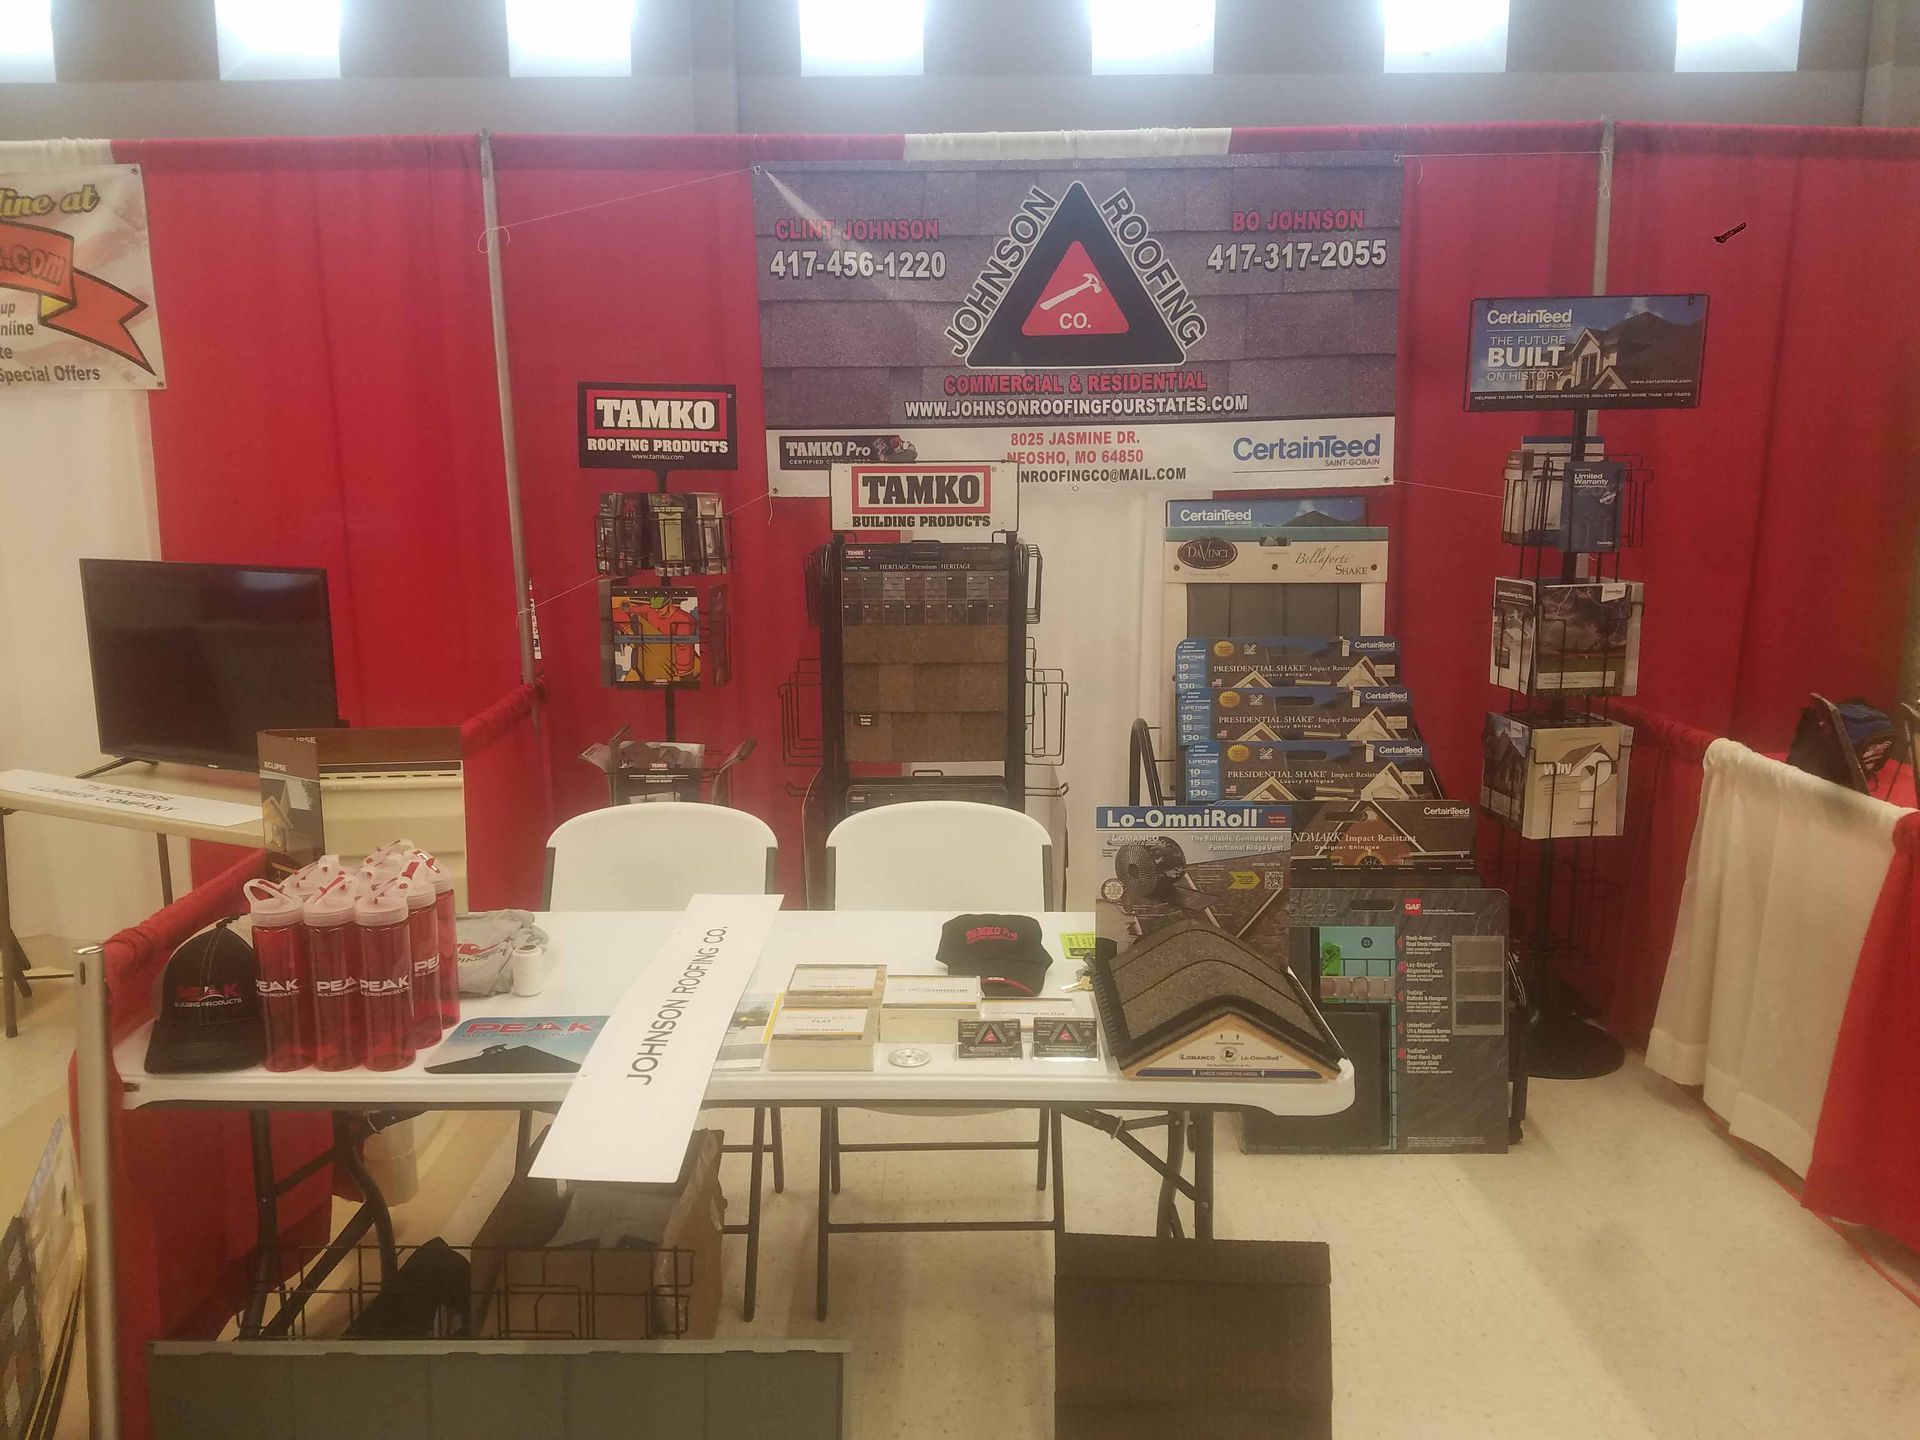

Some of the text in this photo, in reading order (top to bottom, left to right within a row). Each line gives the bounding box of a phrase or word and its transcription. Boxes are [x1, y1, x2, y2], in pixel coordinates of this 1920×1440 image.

[60, 183, 100, 213] at
[1232, 208, 1365, 232] BO JOHNSON
[775, 218, 940, 241] CLINT JOHNSON
[1207, 239, 1387, 272] 417-317-2055
[770, 250, 946, 279] 417-456-1220
[944, 185, 1058, 358] JOHNSON
[1100, 187, 1208, 350] ROOFING
[1059, 312, 1091, 329] CO.
[1487, 308, 1573, 325] CertainTeed
[1490, 335, 1567, 346] THE FUTURE
[1488, 346, 1566, 368] BUILT
[54, 365, 100, 381] Offers
[1487, 370, 1564, 381] ON HISTORY
[944, 371, 1208, 396] COMMERCIAL & RESIDENTIAL
[596, 398, 715, 430] TAMKO
[905, 395, 1249, 418] WWW.JOHNSONROOFINGFOURSTATES.COM
[588, 438, 728, 453] ROOFING PRODUCTS
[1011, 431, 1140, 446] 8025 JASMINE DR.
[786, 442, 871, 456] TAMKO Pro
[1233, 434, 1380, 460] CertainTeed
[632, 453, 684, 461] www.tamko.com
[1007, 450, 1144, 466] NEOSHO, MO 64850
[1324, 458, 1380, 467] SAINT-GOBAIN
[862, 474, 980, 505] TAMKO
[852, 515, 991, 528] BUILDING PRODUCTS
[1180, 509, 1252, 521] CertainTeed
[1335, 565, 1368, 576] SHAKE
[1354, 641, 1395, 649] CertainTeed
[1365, 692, 1408, 700] CertainTeed
[1380, 746, 1423, 754] CertainTeed
[264, 762, 287, 772] ECLIPSE
[29, 785, 180, 812] LUMBER COMPANY
[106, 788, 175, 802] ROGERS
[1107, 808, 1258, 828] Lo-OmniRoll
[1424, 807, 1470, 815] CertainTeed
[1345, 834, 1374, 844] Impact
[360, 975, 409, 992] PEAK
[201, 998, 242, 1008] PRODUCTS
[626, 926, 728, 1086] JOHNSON ROOFING CO.
[466, 1020, 598, 1034] PEAK
